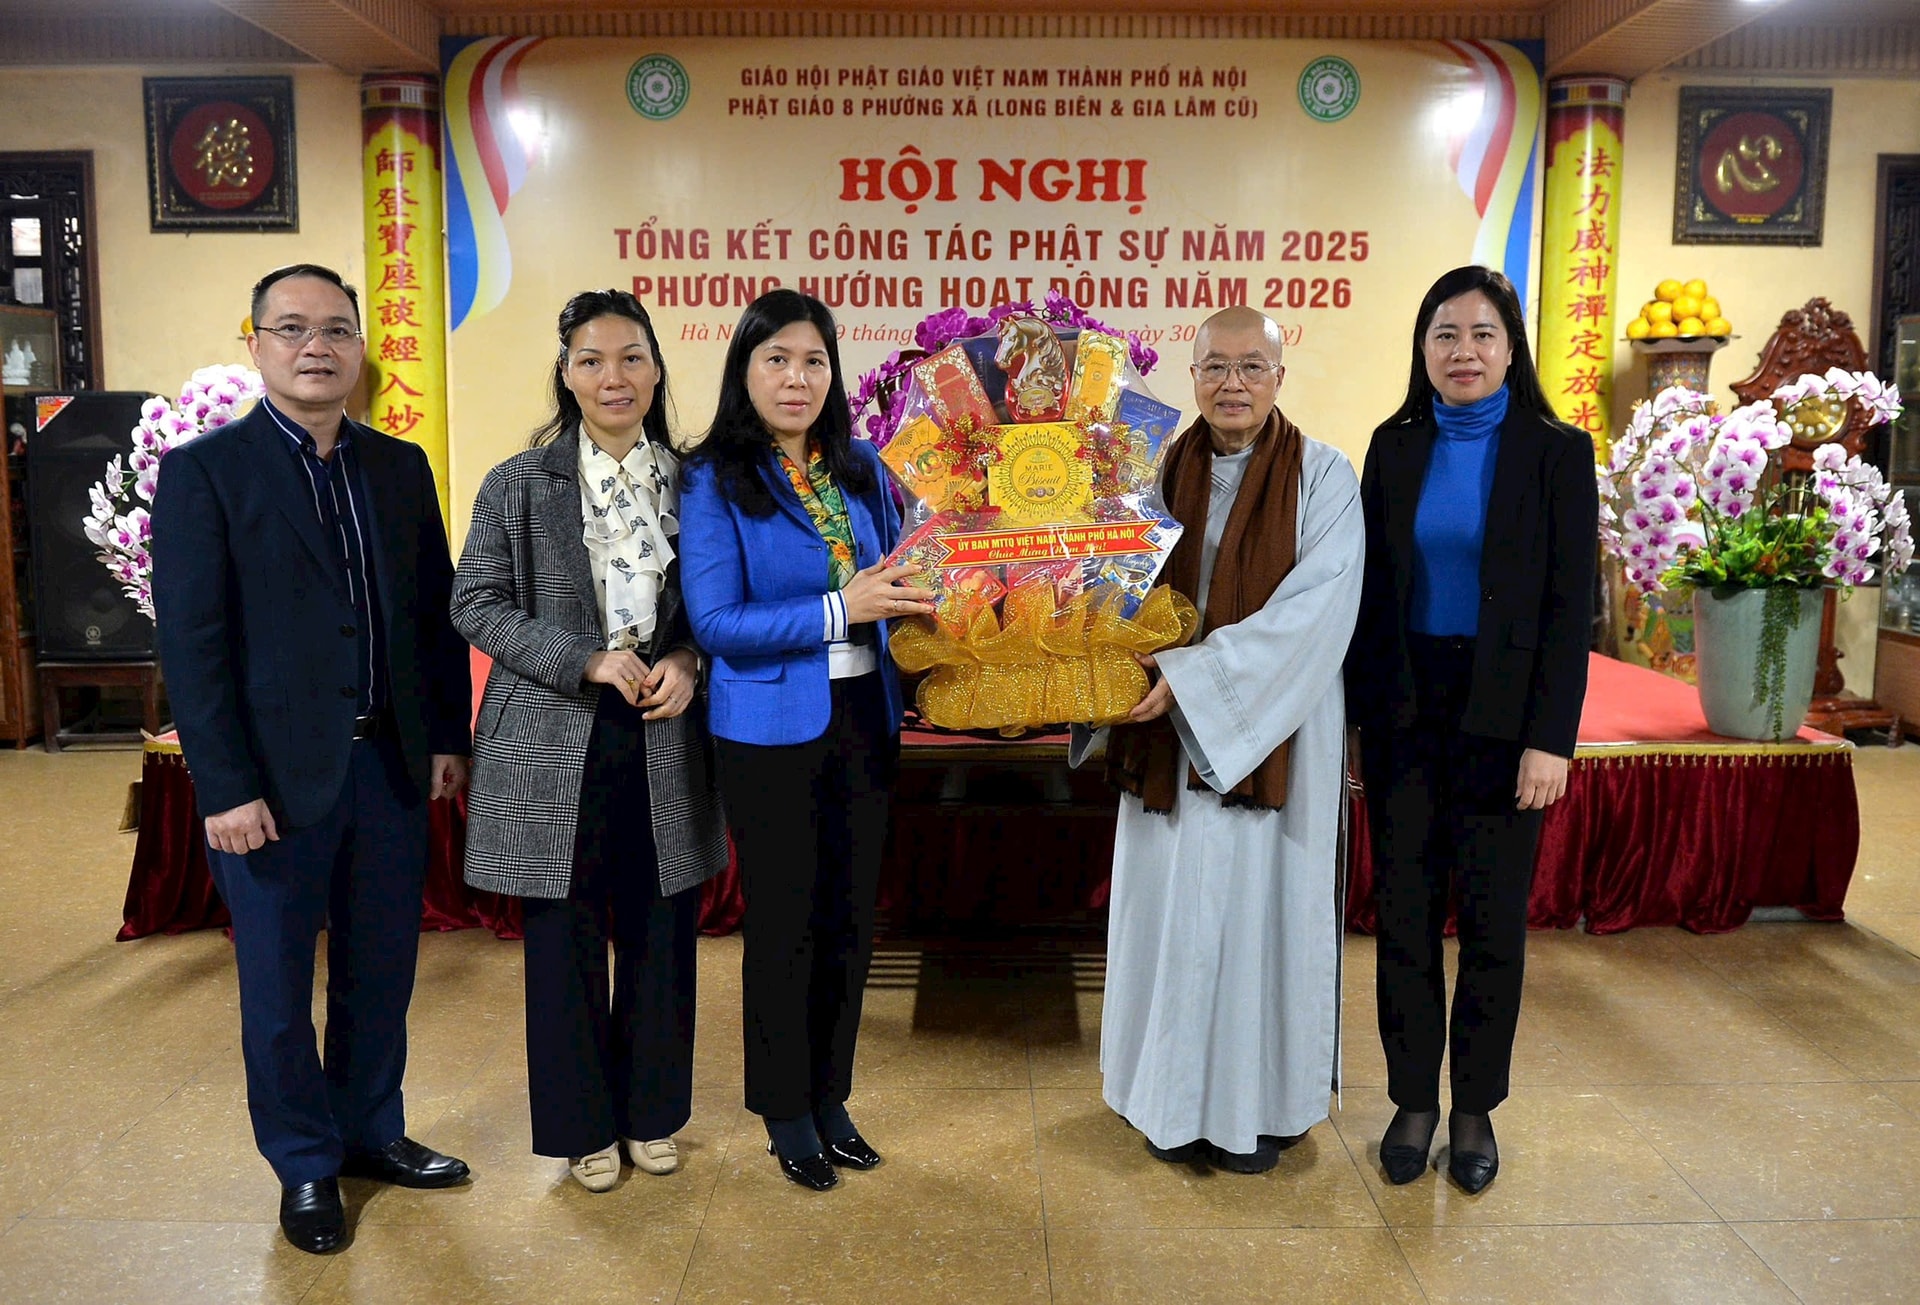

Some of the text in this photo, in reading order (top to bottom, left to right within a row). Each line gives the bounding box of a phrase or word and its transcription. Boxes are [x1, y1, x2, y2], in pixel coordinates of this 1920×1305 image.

[741, 63, 1247, 90] GIÁO HỘI PHẬT GIÁO VIỆT NAM THÀNH PHỐ HÀ NỘI
[728, 97, 778, 119] PHẬT
[788, 97, 834, 116] GIÁO
[843, 98, 853, 116] 8
[952, 97, 977, 116] XÃ
[987, 98, 1046, 118] (LONG
[1055, 97, 1101, 117] BIÊN
[1110, 99, 1124, 117] &
[1133, 99, 1165, 117] GIA
[1175, 97, 1216, 117] LÂM
[1225, 97, 1258, 118] CŨ)
[839, 144, 1148, 216] HỘI NGHỊ
[614, 216, 1369, 268] TỔNG KẾT CÔNG TÁC PHẬT SỰ NĂM 2025
[799, 270, 922, 308] HƯỚNG
[1165, 271, 1248, 308] NĂM
[1263, 277, 1352, 308] 2026
[1562, 147, 1615, 452] 法力威神禪定放光
[680, 323, 709, 341] Hà
[852, 323, 912, 346] tháng
[1279, 324, 1303, 346] ỵ)
[1019, 471, 1061, 487] Biscuit
[1025, 464, 1053, 472] MARIE
[971, 540, 989, 550] BAN
[991, 537, 1015, 549] MTTQ
[1016, 535, 1034, 547] VIỆT
[1036, 534, 1057, 545] NAM
[1088, 528, 1105, 542] PHỐ
[1107, 529, 1118, 540] HÀ
[1120, 528, 1135, 541] NỘI
